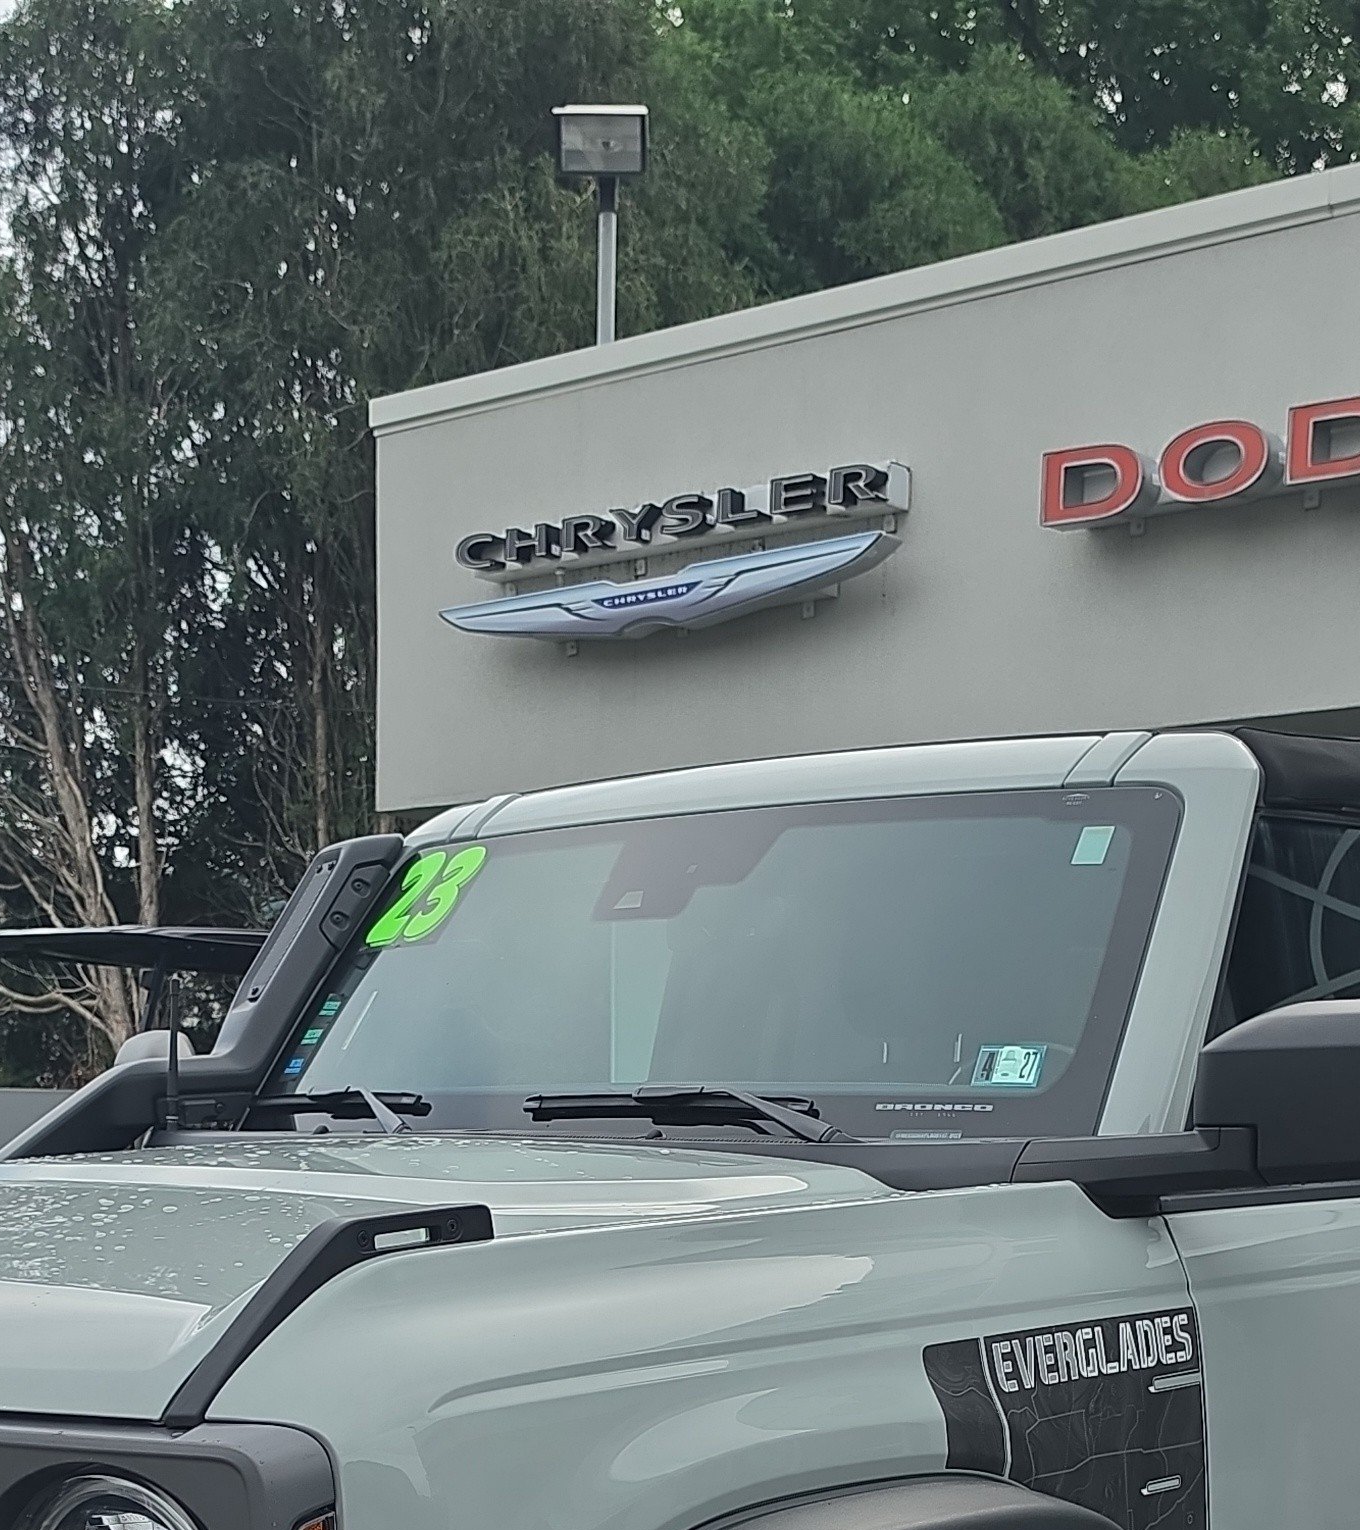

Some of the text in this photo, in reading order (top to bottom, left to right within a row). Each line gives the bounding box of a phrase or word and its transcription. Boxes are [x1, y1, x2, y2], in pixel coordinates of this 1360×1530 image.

[455, 463, 890, 570] CHRYSLER
[603, 586, 688, 607] CHRYSLER
[366, 846, 487, 948] 23
[980, 1052, 1039, 1081] 4 27
[991, 1313, 1193, 1393] EVERGLADES
